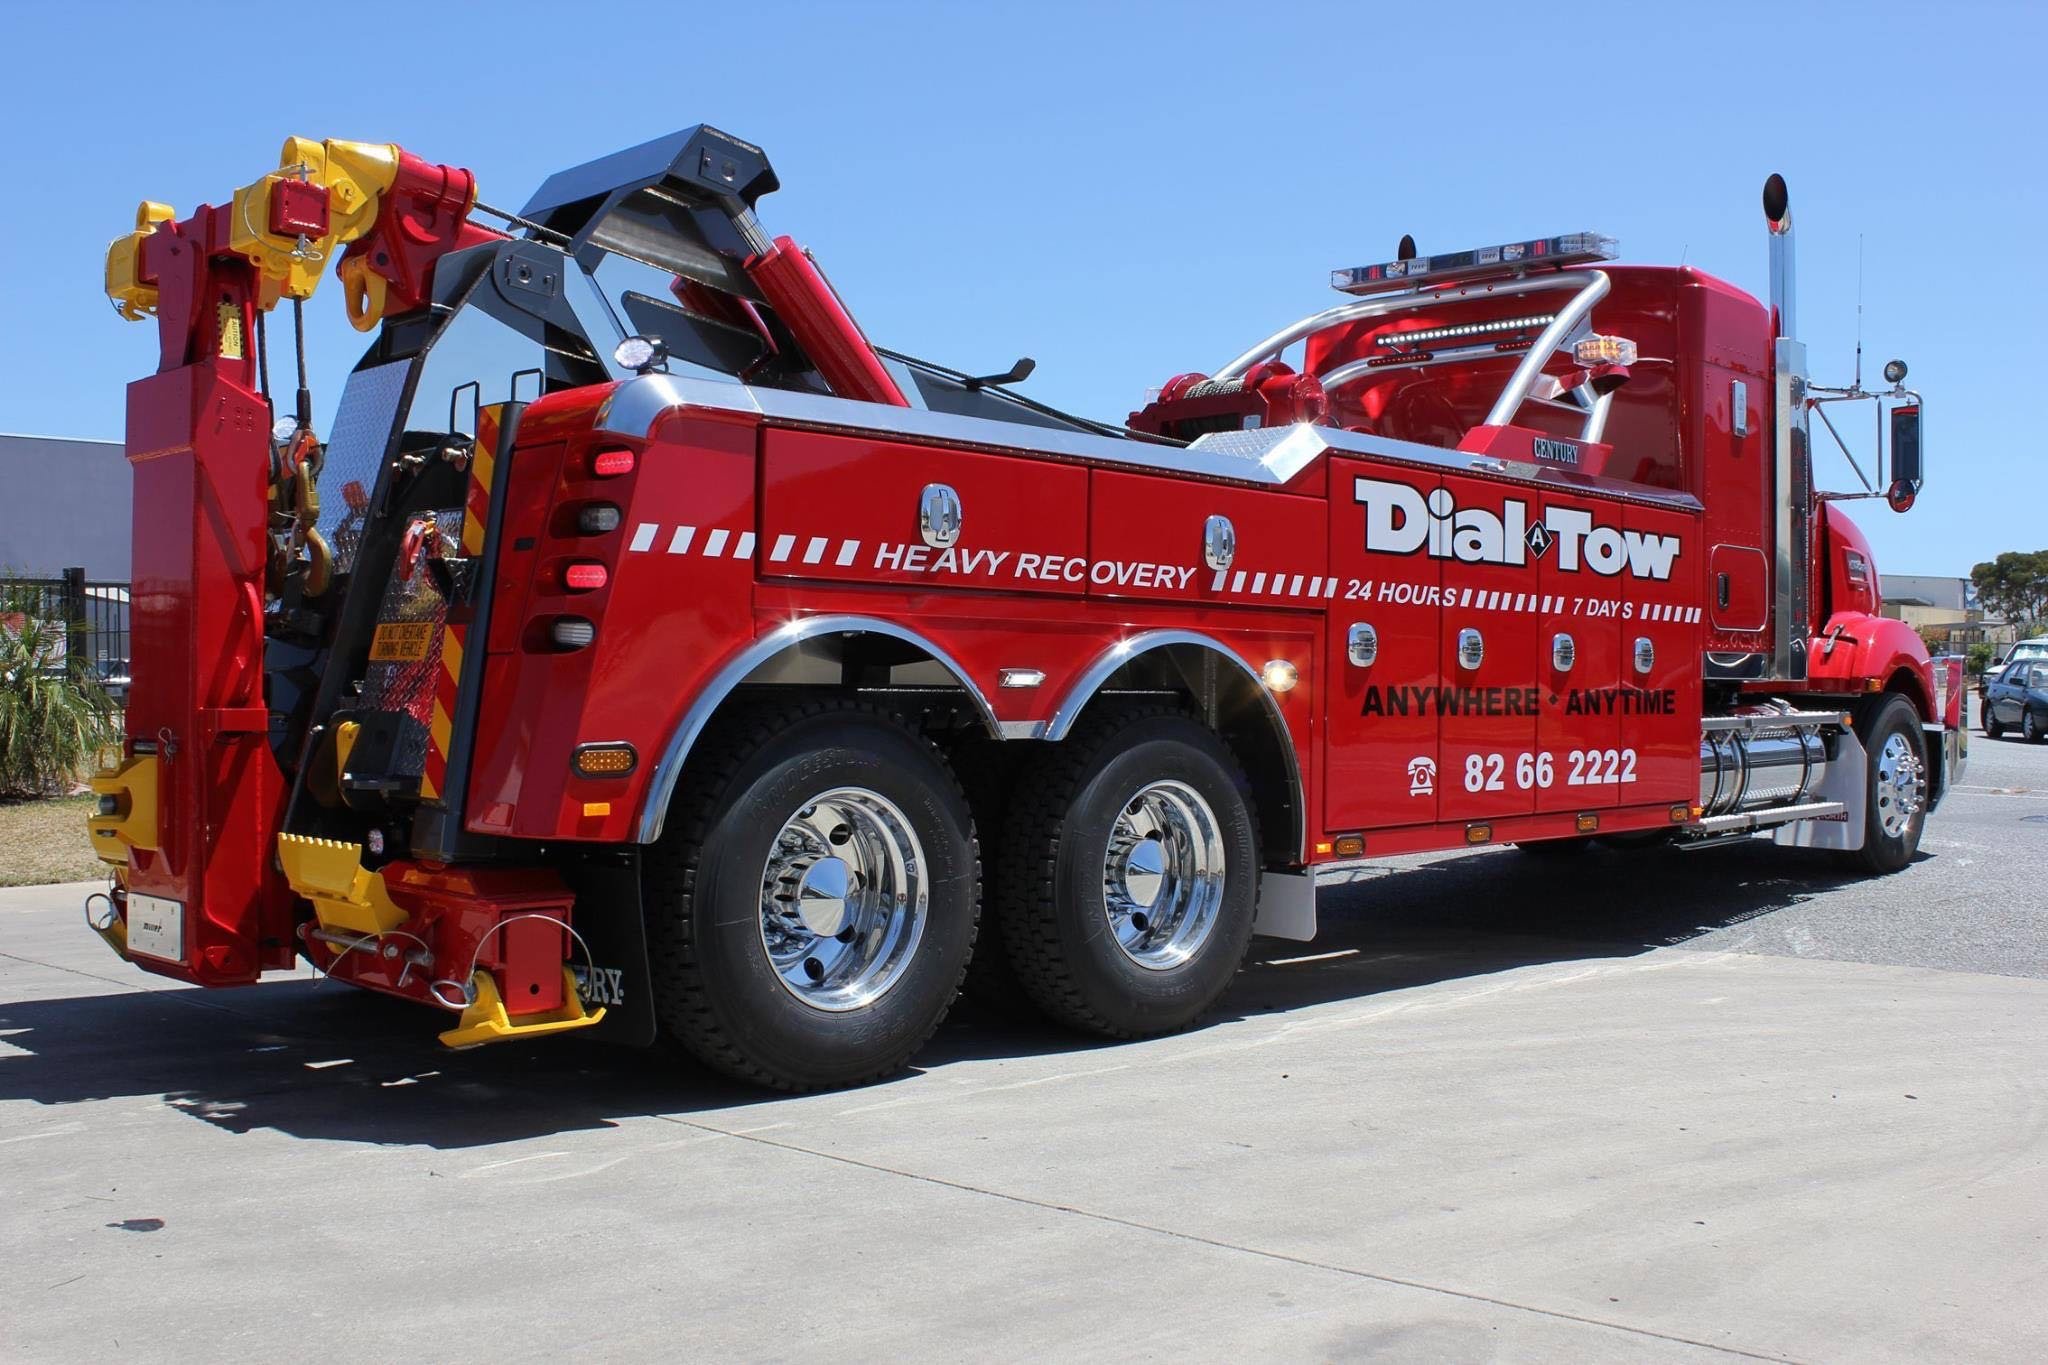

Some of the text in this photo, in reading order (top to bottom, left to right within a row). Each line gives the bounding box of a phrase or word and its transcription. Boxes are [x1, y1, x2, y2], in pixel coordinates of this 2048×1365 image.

[1534, 437, 1579, 464] CENTURY
[1354, 477, 1526, 566] Dial
[1531, 529, 1545, 549] A
[874, 543, 1197, 589] HEAVY RECOVERY
[1345, 579, 1457, 607] 24 HOURS
[1572, 598, 1634, 620] 7 DAYS
[1361, 685, 1676, 717] ANYWHERE ANYTIME
[1464, 748, 1638, 793] 82 66 2222
